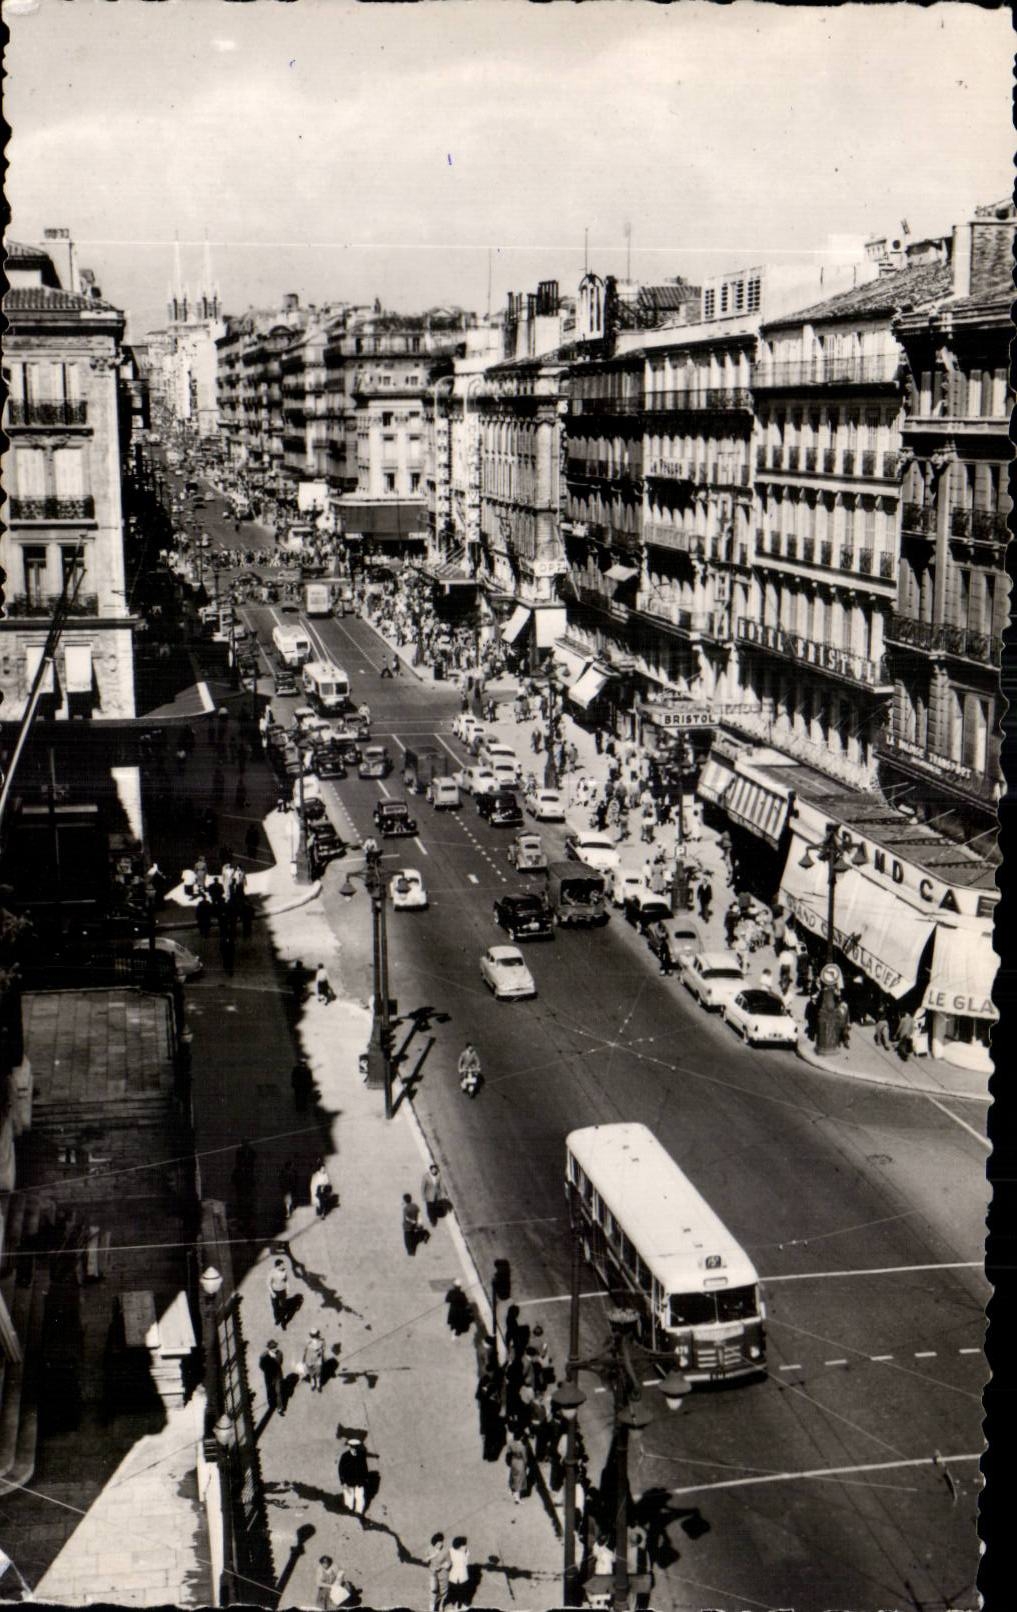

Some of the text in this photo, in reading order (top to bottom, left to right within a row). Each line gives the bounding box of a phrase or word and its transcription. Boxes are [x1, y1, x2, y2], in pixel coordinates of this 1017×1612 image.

[739, 619, 875, 685] HOTEL BRISTOL
[664, 714, 715, 725] BRISTOL
[834, 824, 904, 884] RAND
[927, 989, 995, 1015] LE GLA
